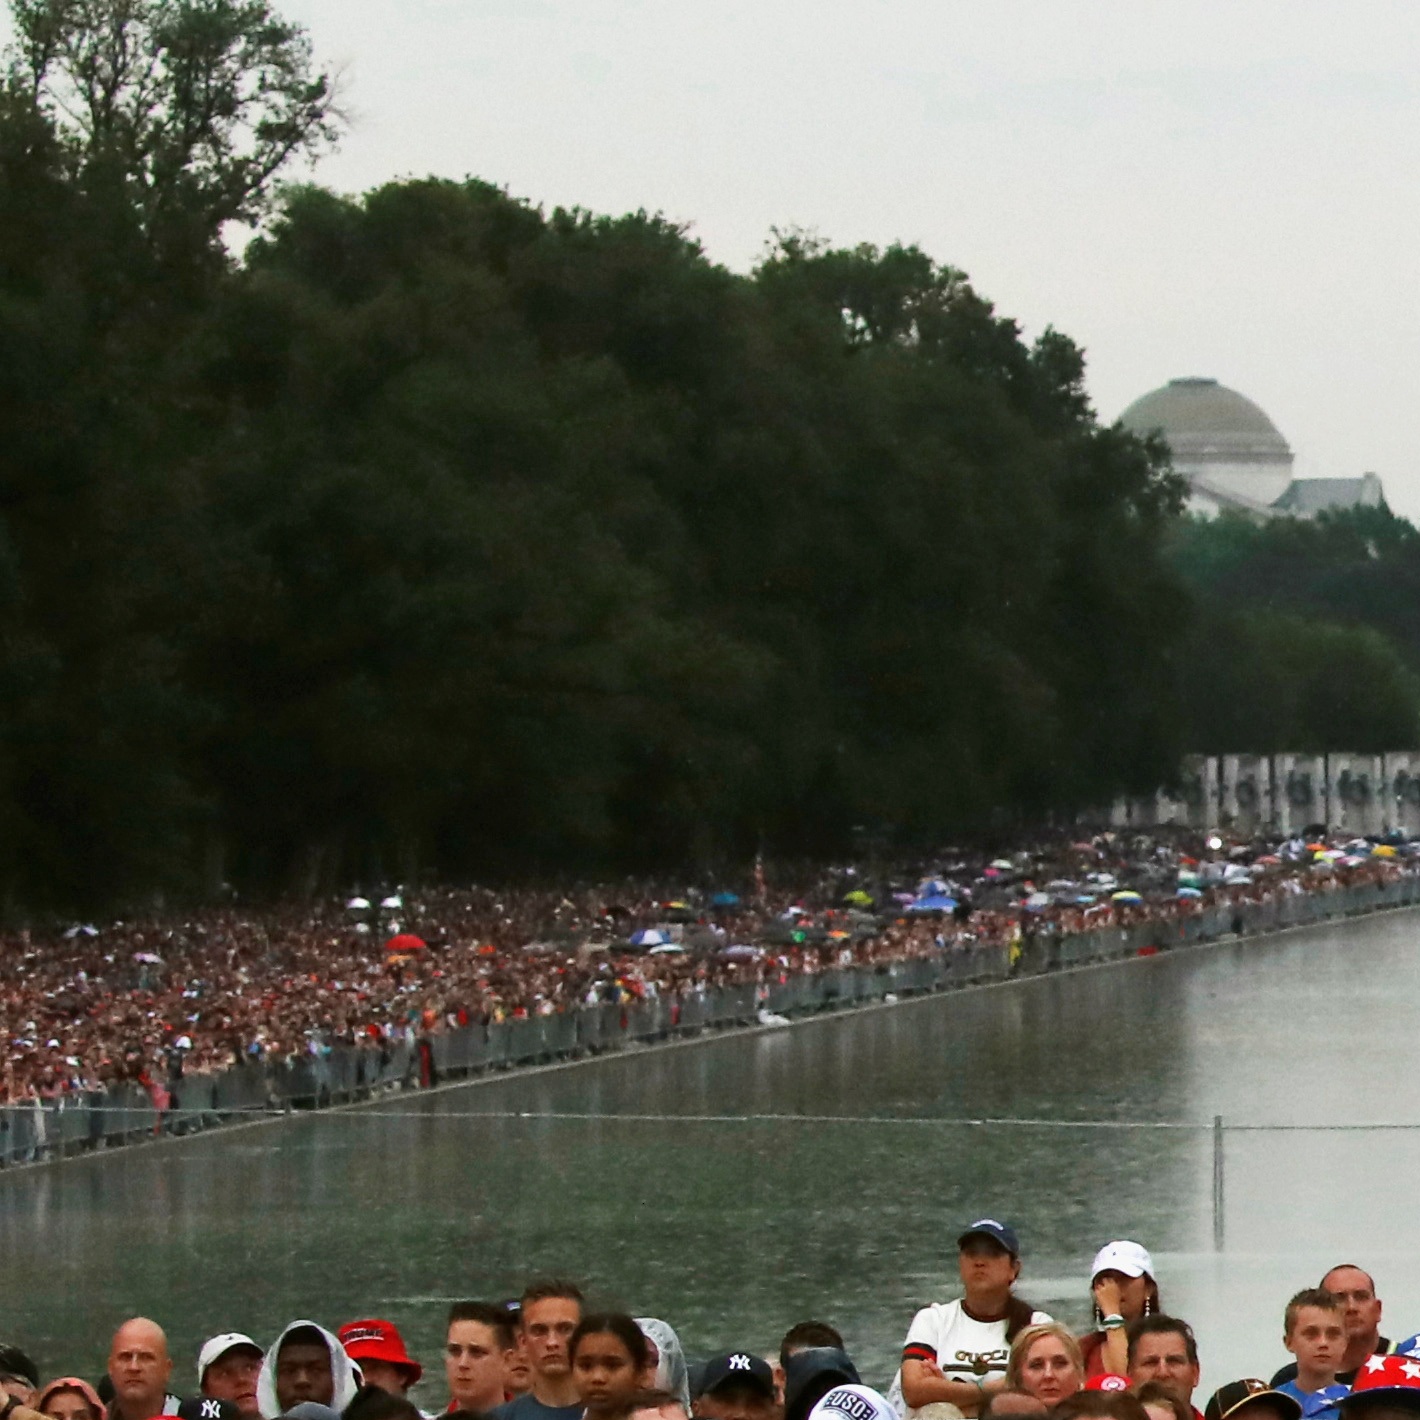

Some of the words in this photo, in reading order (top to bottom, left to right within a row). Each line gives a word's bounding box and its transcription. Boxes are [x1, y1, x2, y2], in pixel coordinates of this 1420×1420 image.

[729, 1354, 751, 1371] NY
[955, 1350, 1009, 1363] GUCCI
[201, 1400, 221, 1418] NY
[831, 1392, 867, 1418] USO
